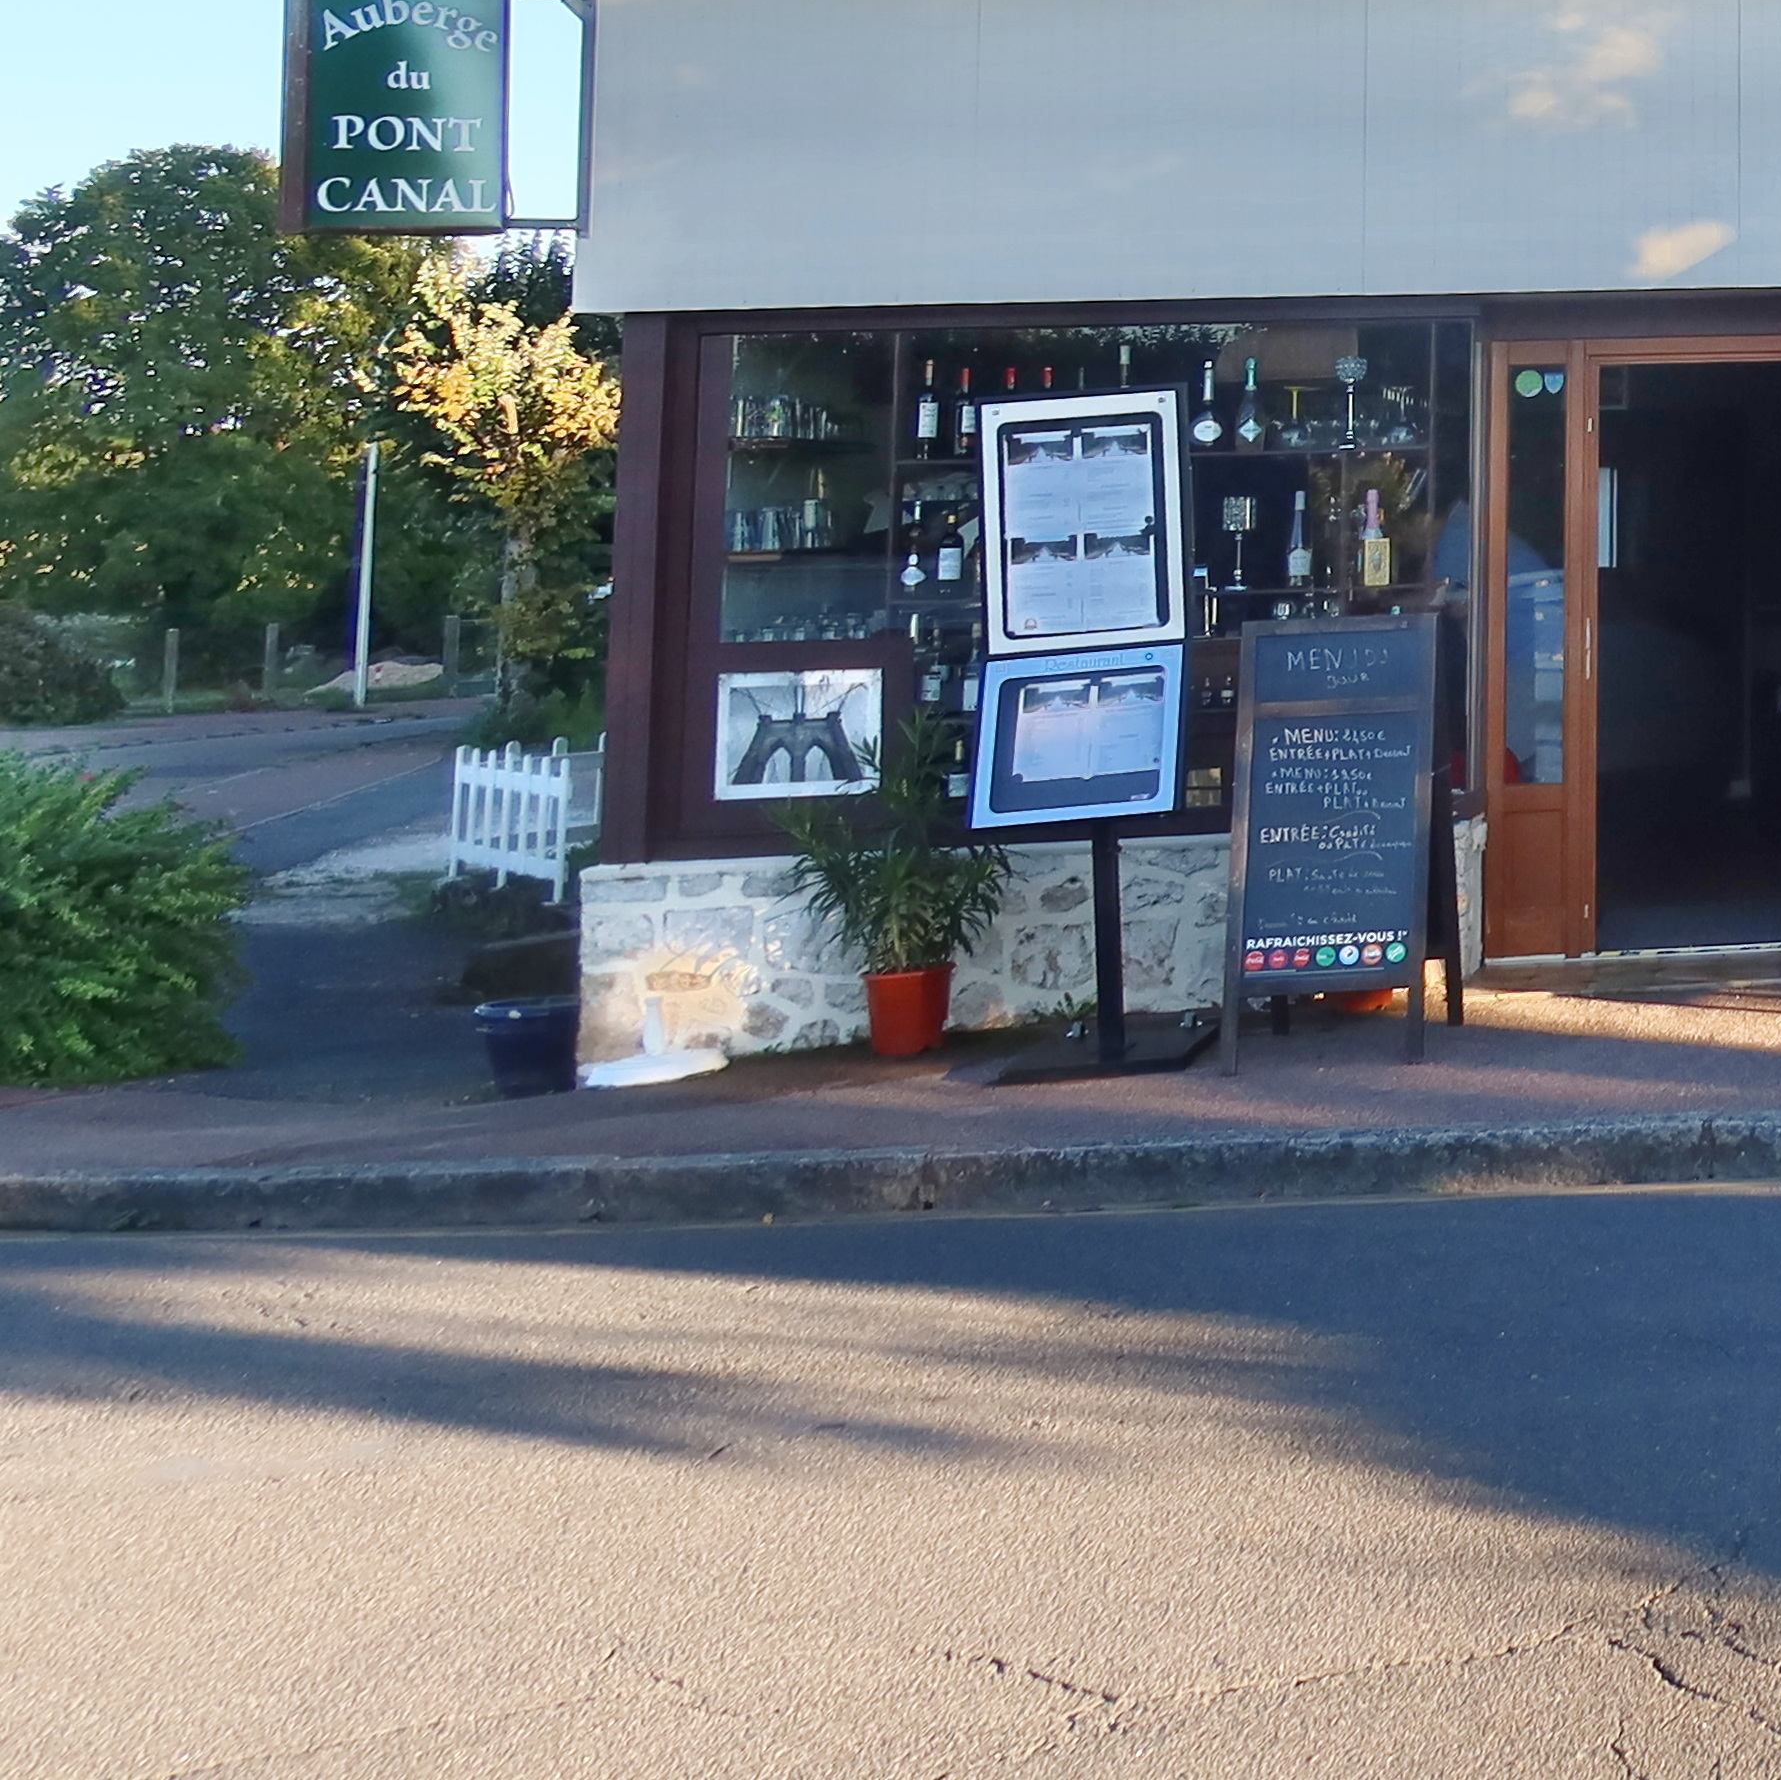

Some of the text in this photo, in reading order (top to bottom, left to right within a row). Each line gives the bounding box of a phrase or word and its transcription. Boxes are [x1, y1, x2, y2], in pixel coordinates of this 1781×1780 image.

[386, 60, 432, 91] du
[331, 114, 483, 153] PONT
[316, 175, 498, 214] CANAL
[1044, 652, 1127, 672] Restaurant
[1245, 933, 1395, 951] RAFRAICHISSEZ-VOUS
